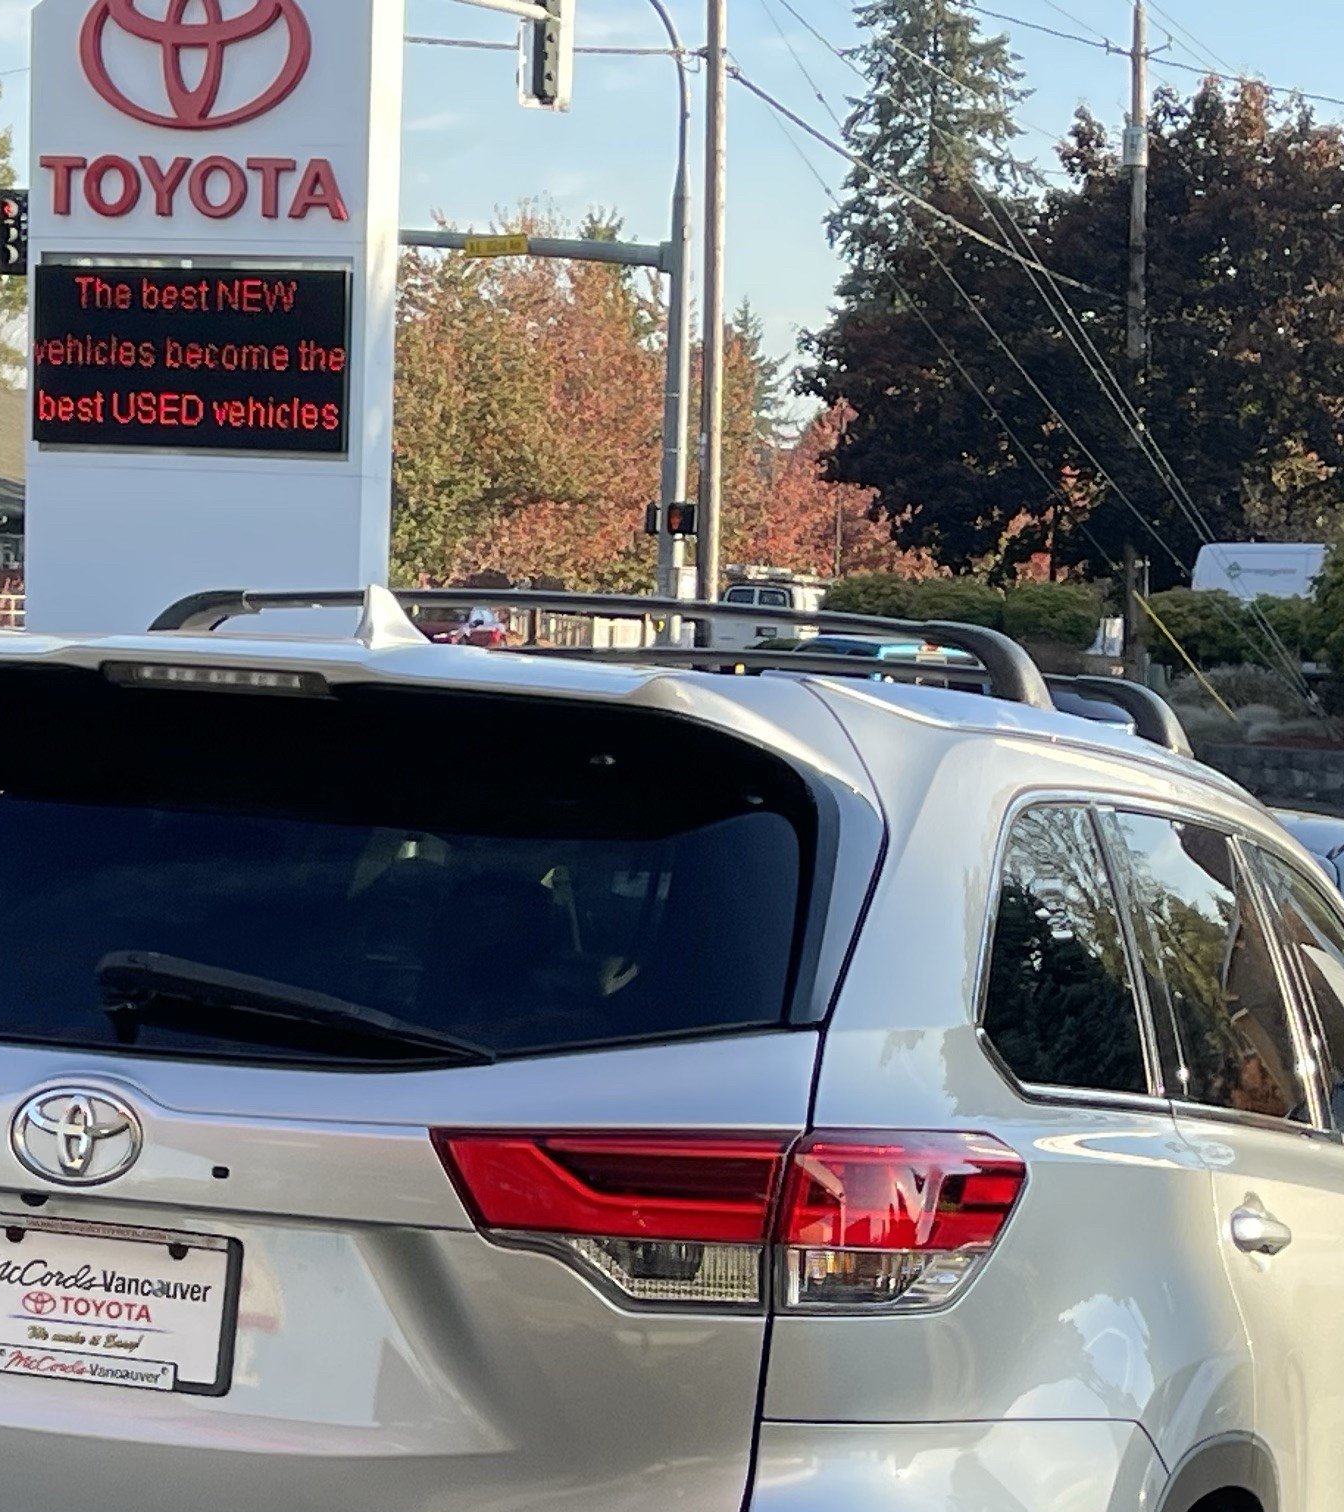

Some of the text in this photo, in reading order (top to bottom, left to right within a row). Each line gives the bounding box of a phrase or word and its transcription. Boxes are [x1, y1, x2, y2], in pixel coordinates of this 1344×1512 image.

[40, 155, 349, 222] TOYOTA
[74, 275, 297, 314] The best NEW
[33, 332, 346, 374] vehicles become the
[37, 388, 340, 433] best USED vehicles
[60, 1296, 152, 1323] TOYOTA
